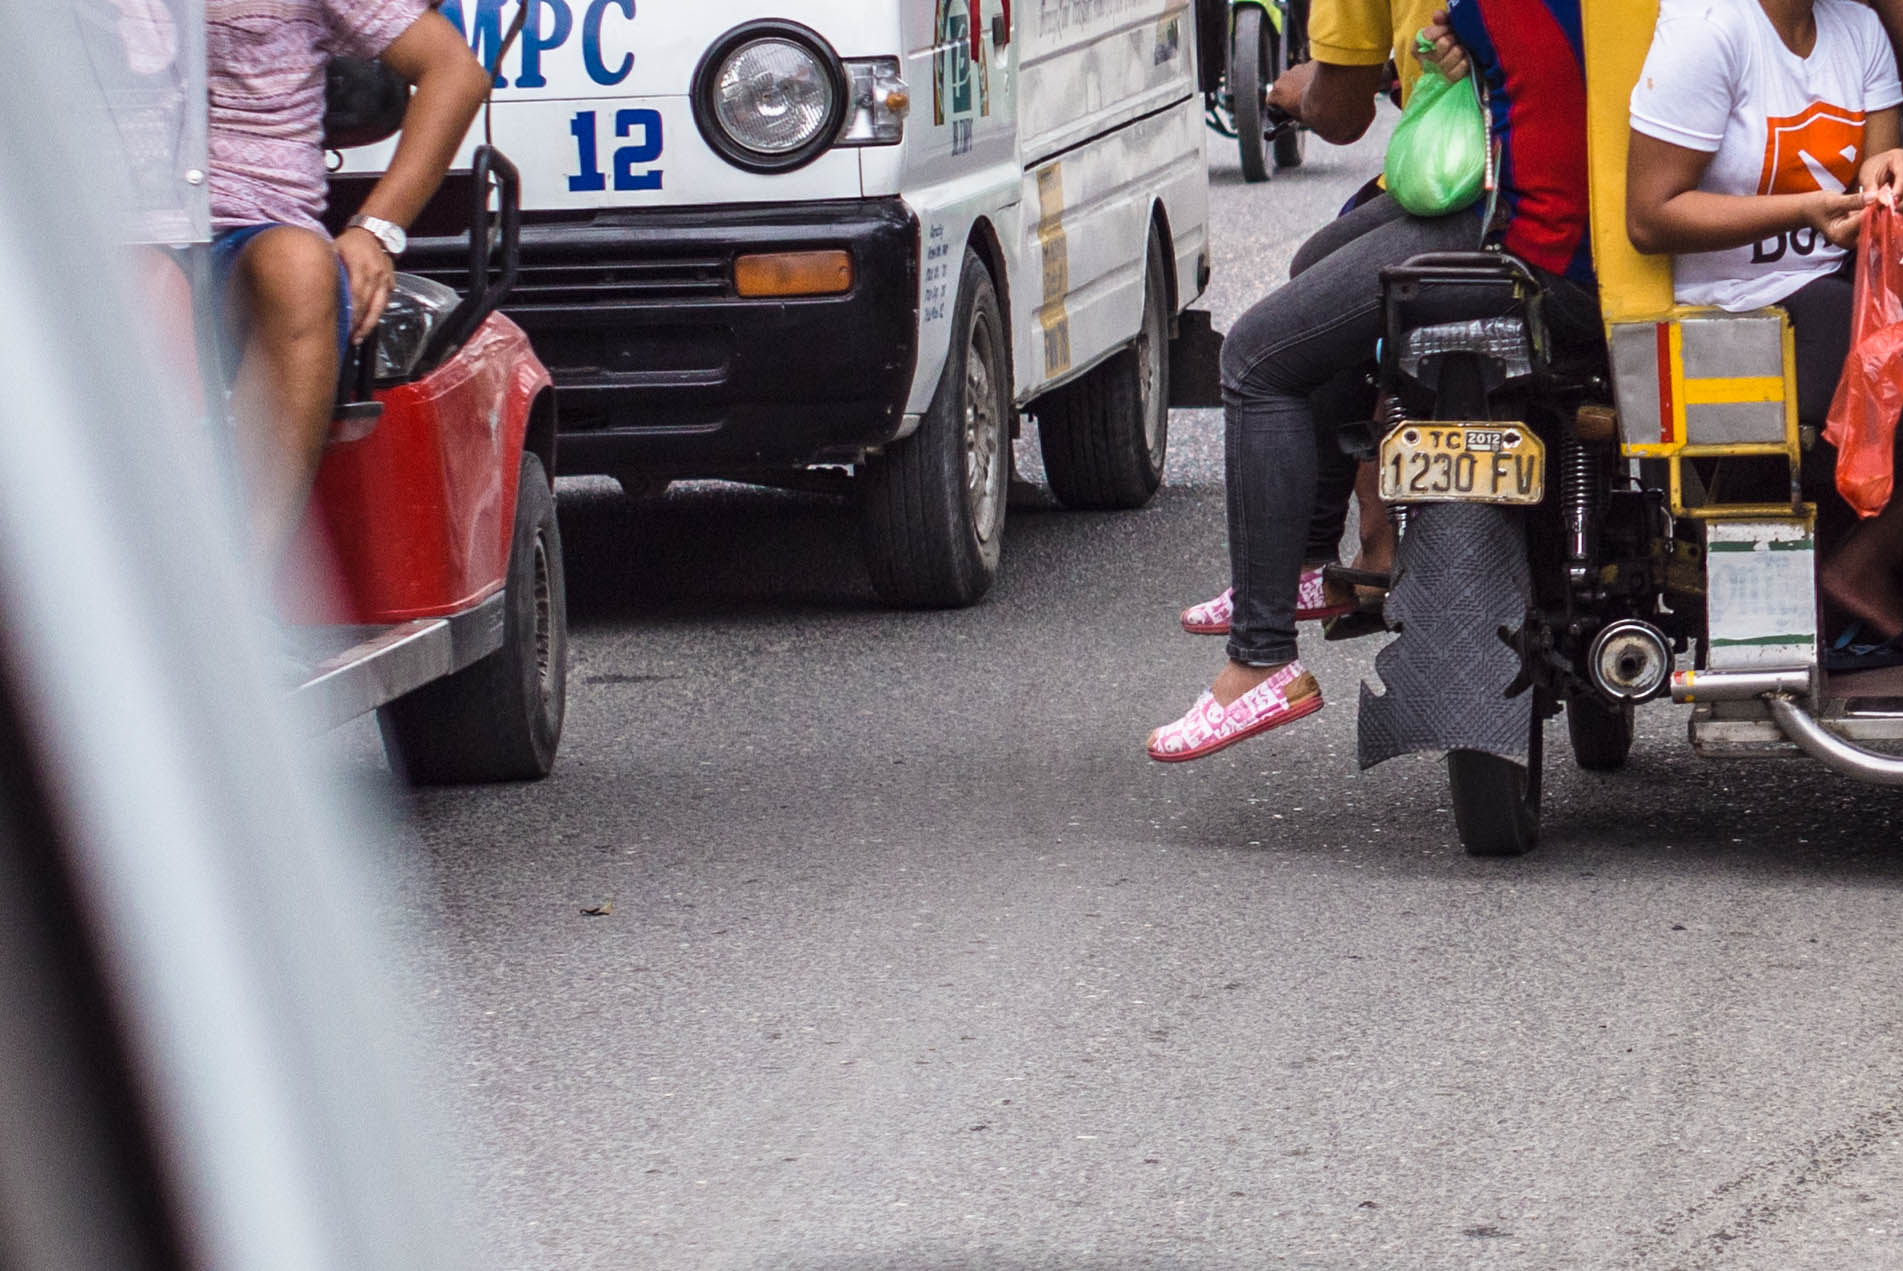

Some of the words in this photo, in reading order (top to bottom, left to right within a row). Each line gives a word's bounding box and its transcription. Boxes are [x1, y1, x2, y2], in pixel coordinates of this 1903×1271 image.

[569, 108, 663, 192] 12
[1429, 431, 1462, 450] TC
[1467, 433, 1501, 444] 2012
[1391, 451, 1478, 496] 1230
[1490, 452, 1535, 495] FV
